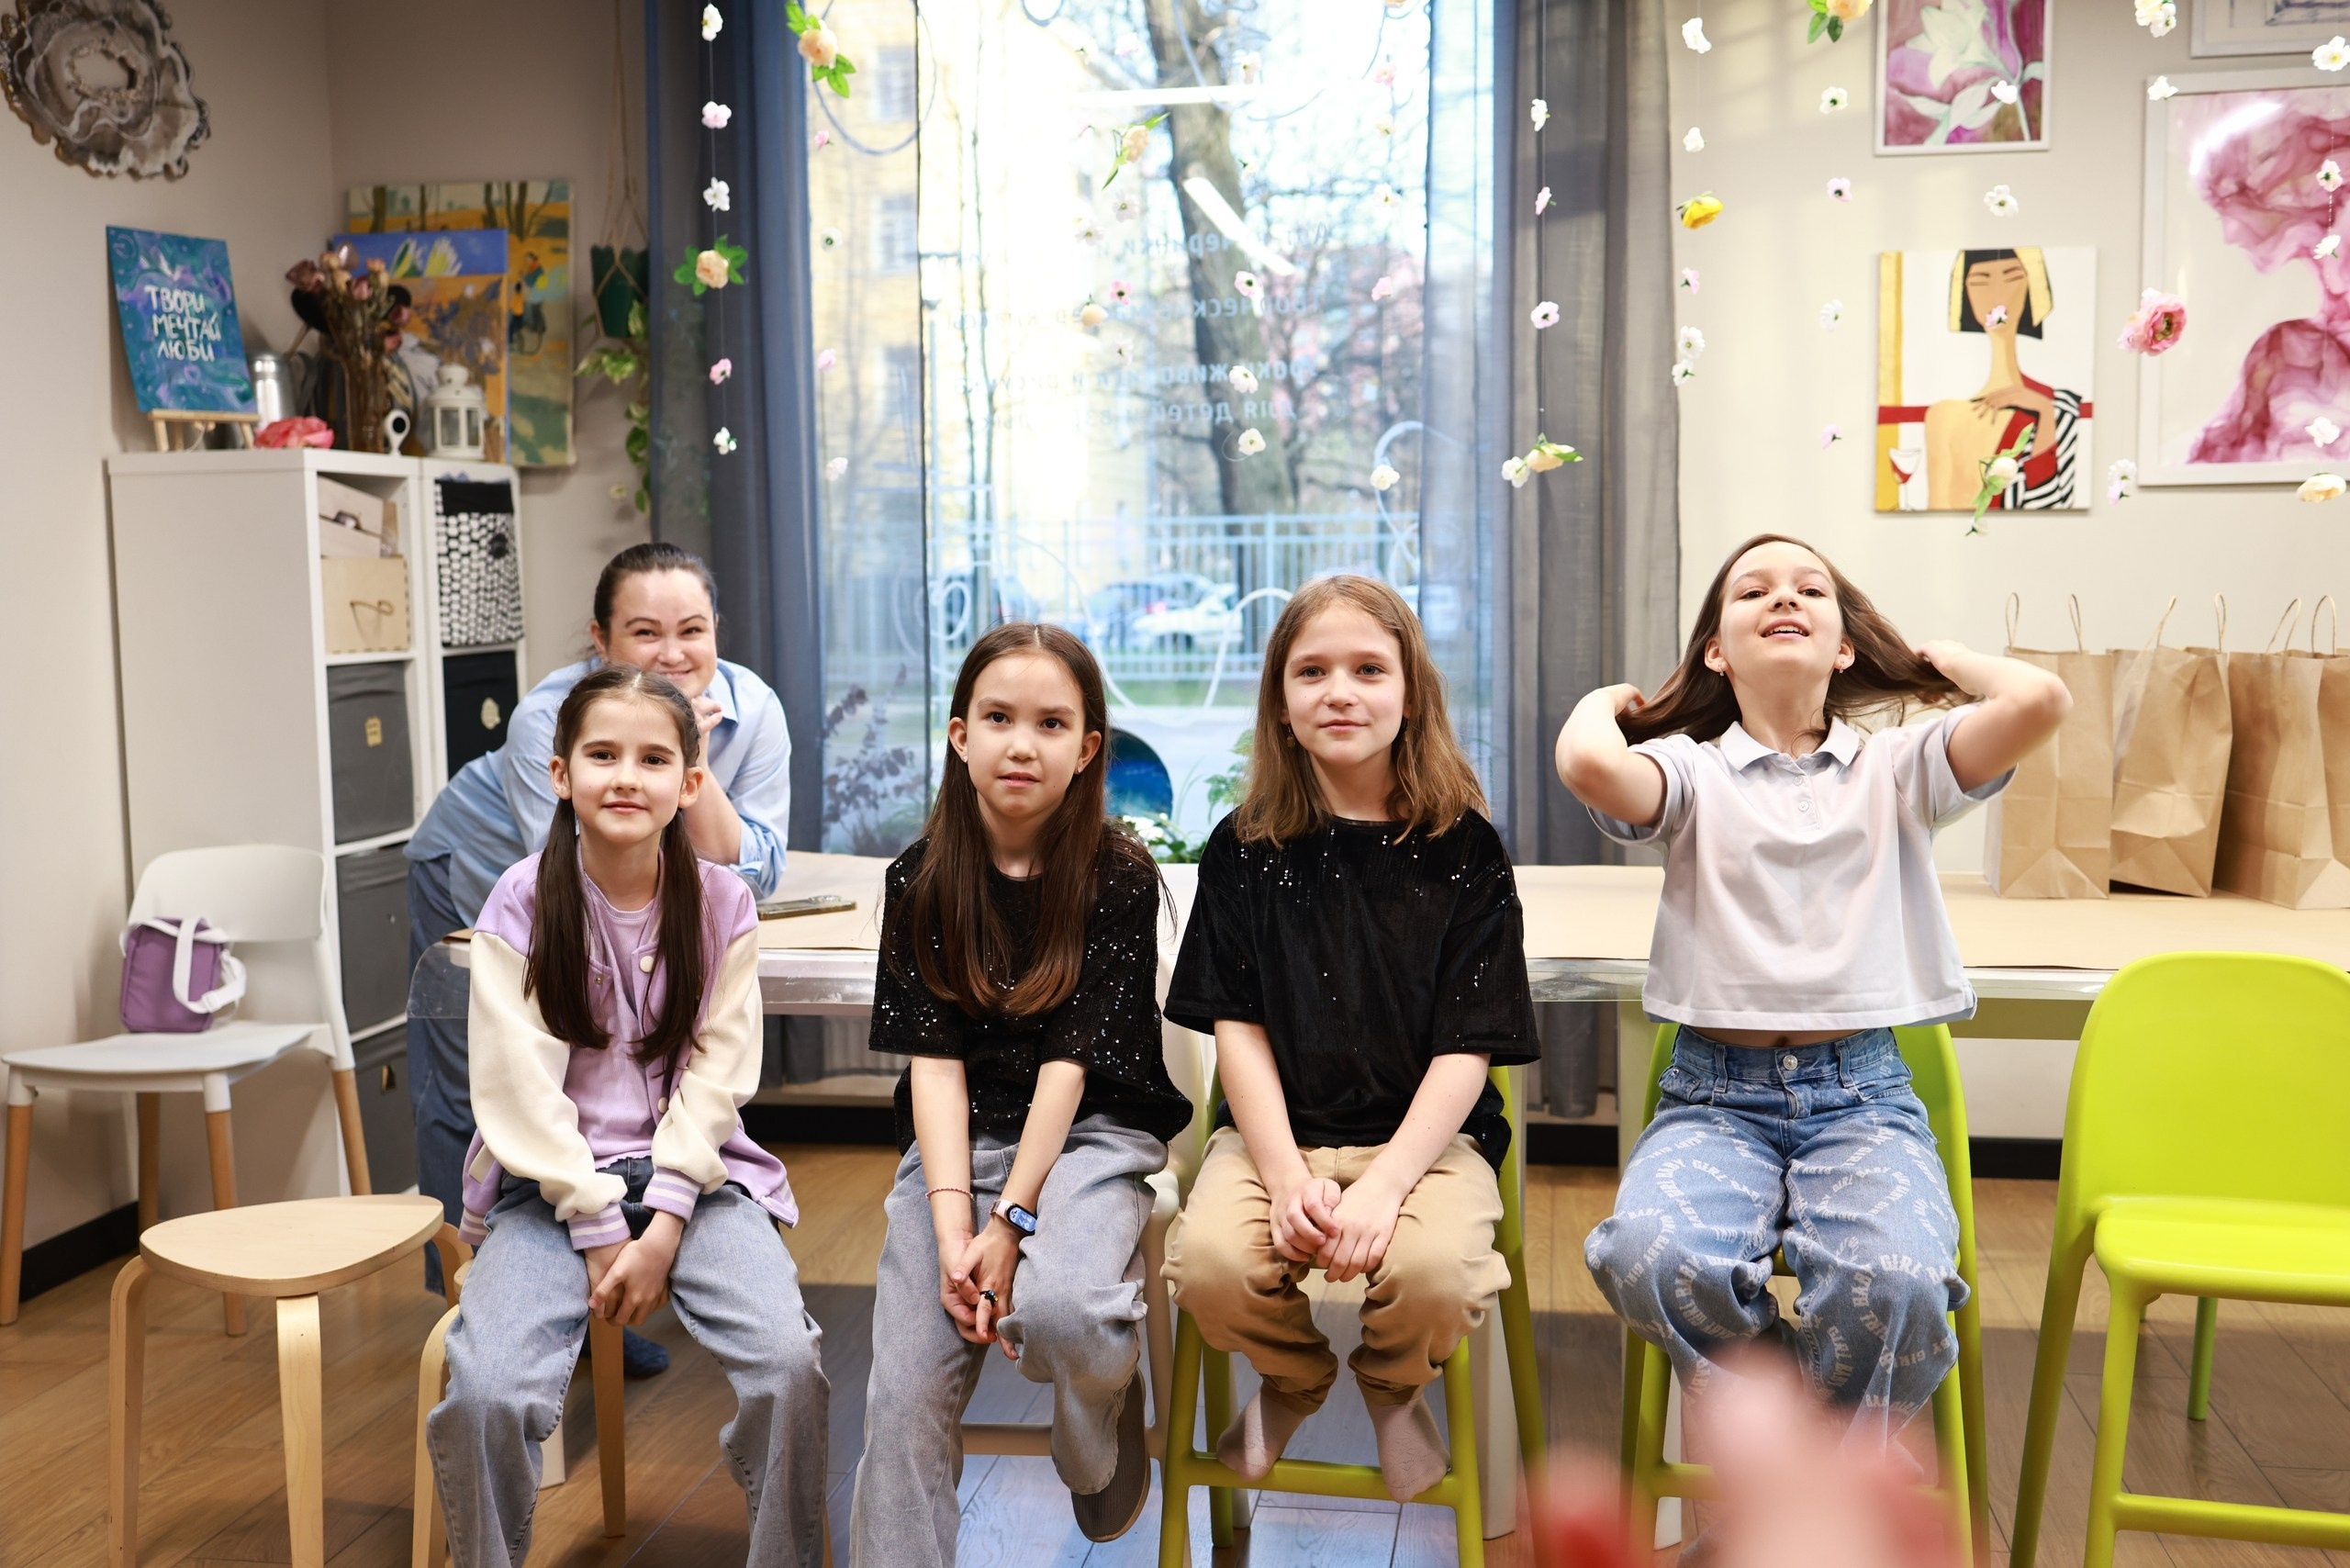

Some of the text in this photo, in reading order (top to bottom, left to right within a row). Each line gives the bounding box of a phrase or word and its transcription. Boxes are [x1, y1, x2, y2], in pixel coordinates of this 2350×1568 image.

[144, 285, 206, 315] ТВОРИ
[151, 312, 222, 342] МЕЧТАЙ
[157, 340, 215, 362] ЛЮБИ
[1655, 1159, 1686, 1178] BABY
[1692, 1159, 1729, 1182] GIRL
[1832, 1174, 1853, 1193] GIRL
[1855, 1167, 1891, 1179] BABY
[1656, 1180, 1685, 1198] GIRL
[1676, 1198, 1707, 1228] BABY
[1643, 1234, 1671, 1265] BABY
[1624, 1262, 1645, 1287] GIRL
[1674, 1256, 1705, 1298] BABY
[1852, 1263, 1877, 1307] BABY
[1879, 1253, 1922, 1279] GIRL
[1679, 1298, 1707, 1327] GIRL
[1827, 1325, 1853, 1388] GIRL BABY
